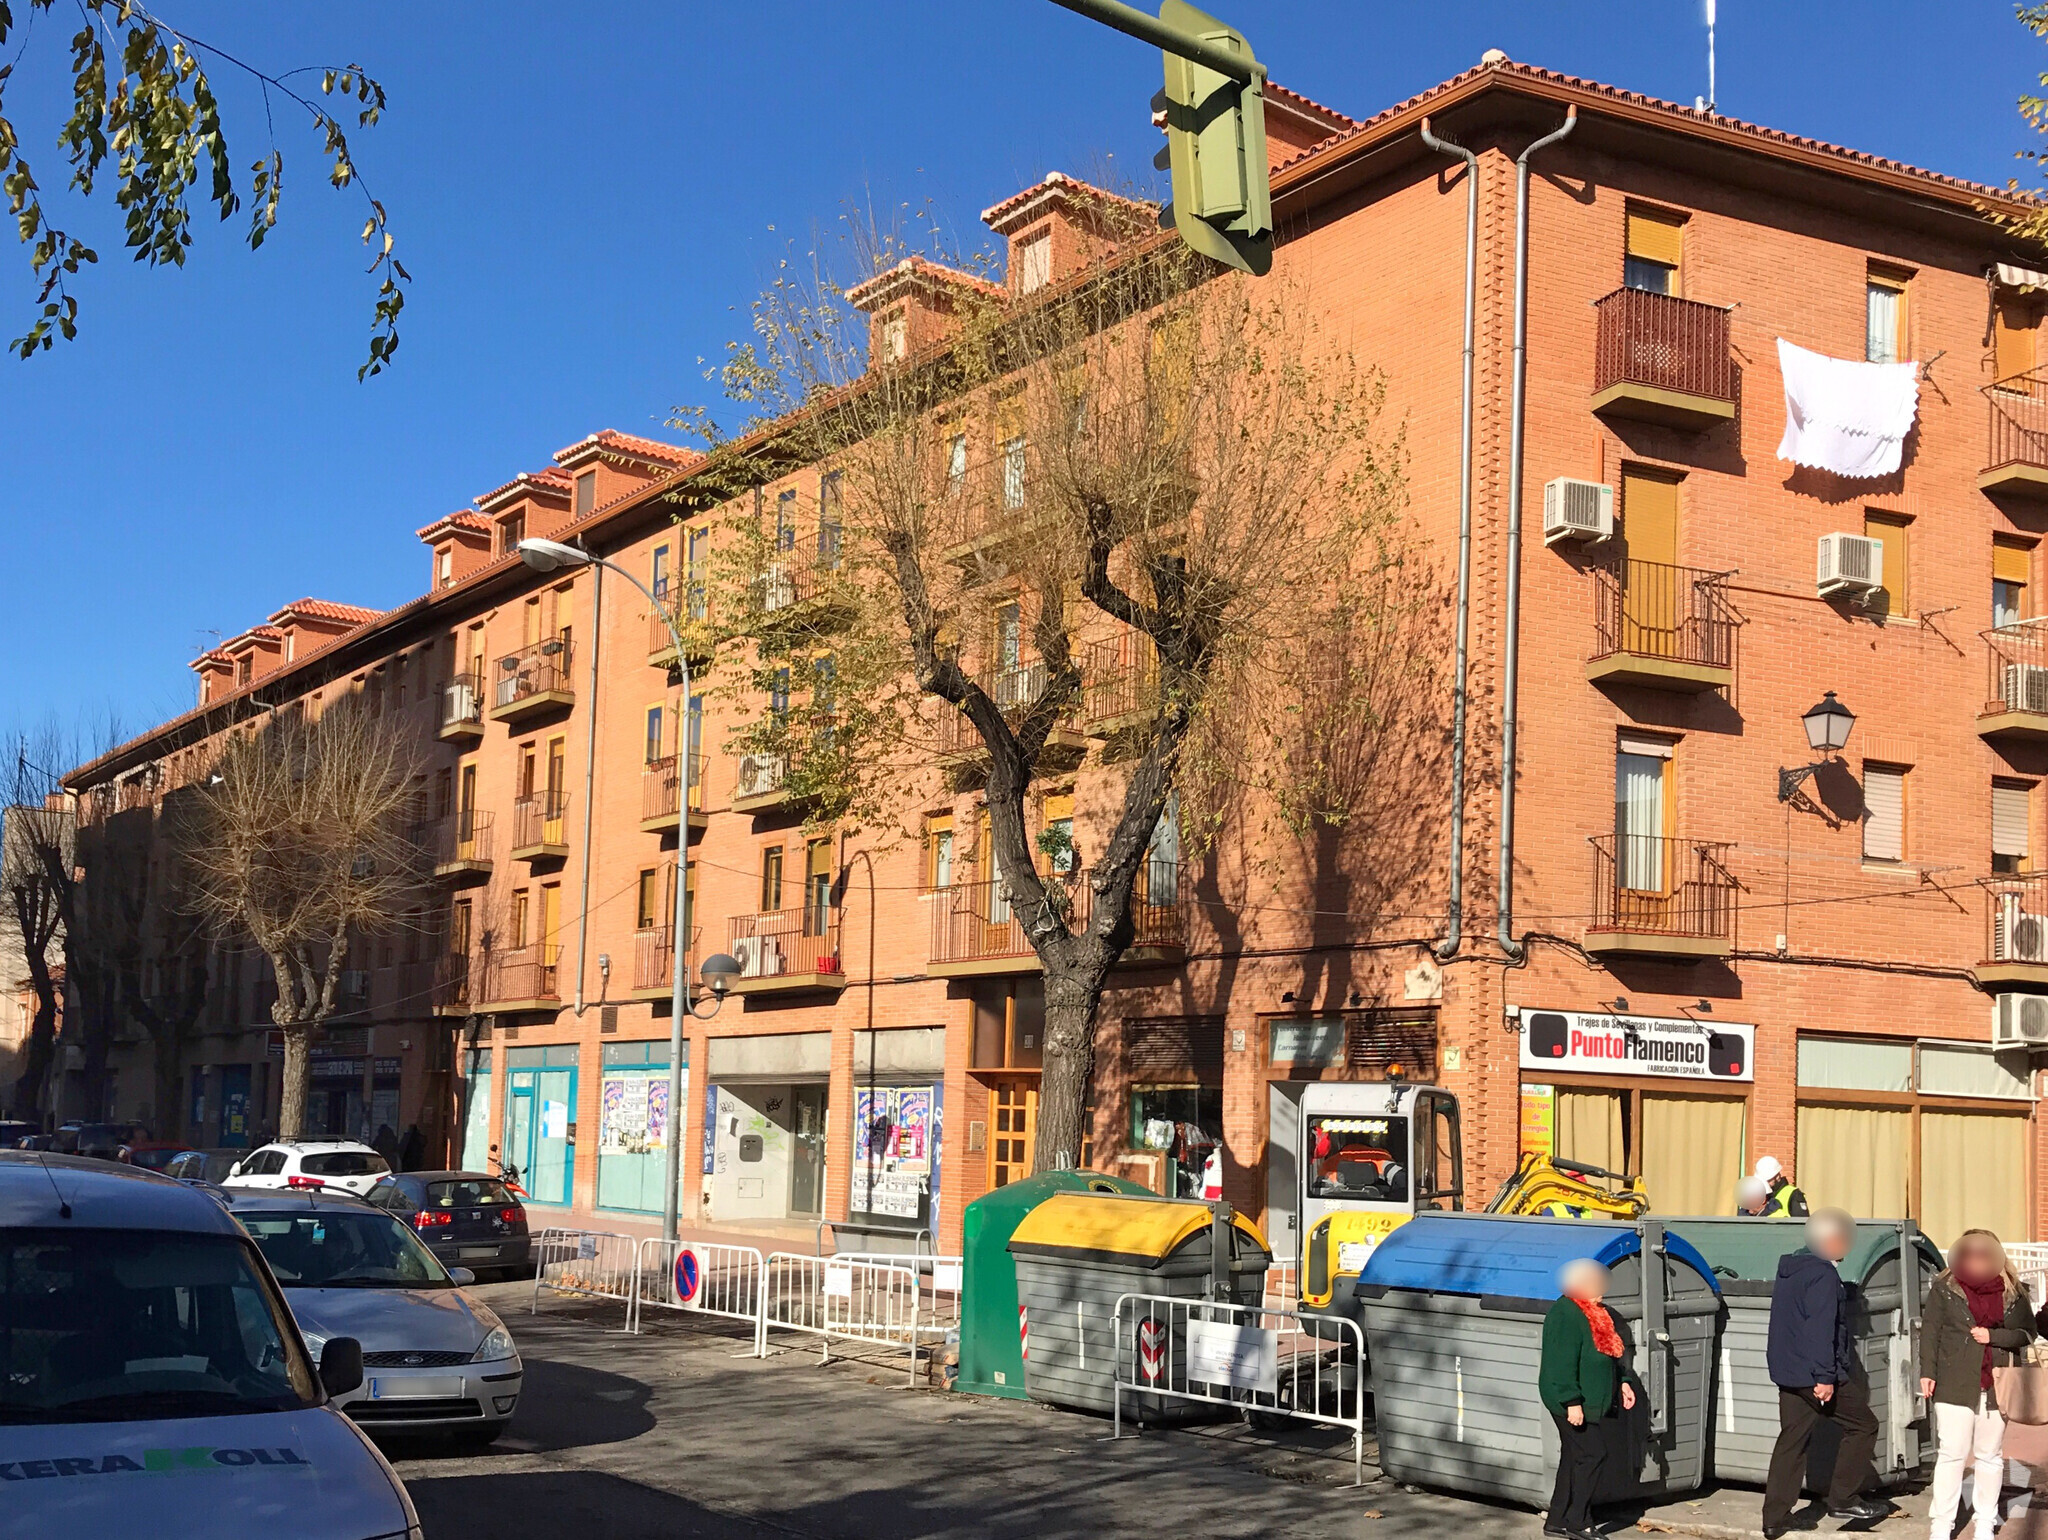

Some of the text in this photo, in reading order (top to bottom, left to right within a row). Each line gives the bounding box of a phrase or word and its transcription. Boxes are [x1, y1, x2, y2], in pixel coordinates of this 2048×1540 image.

[1577, 1016, 1600, 1028] Trajes
[1601, 1018, 1610, 1029] de
[1648, 1022, 1653, 1032] y
[1654, 1021, 1703, 1034] Complementos
[1680, 1066, 1705, 1074] ESPAÑOLA
[1537, 1101, 1551, 1110] tipo
[1531, 1113, 1541, 1121] de
[1347, 1218, 1391, 1233] 1492
